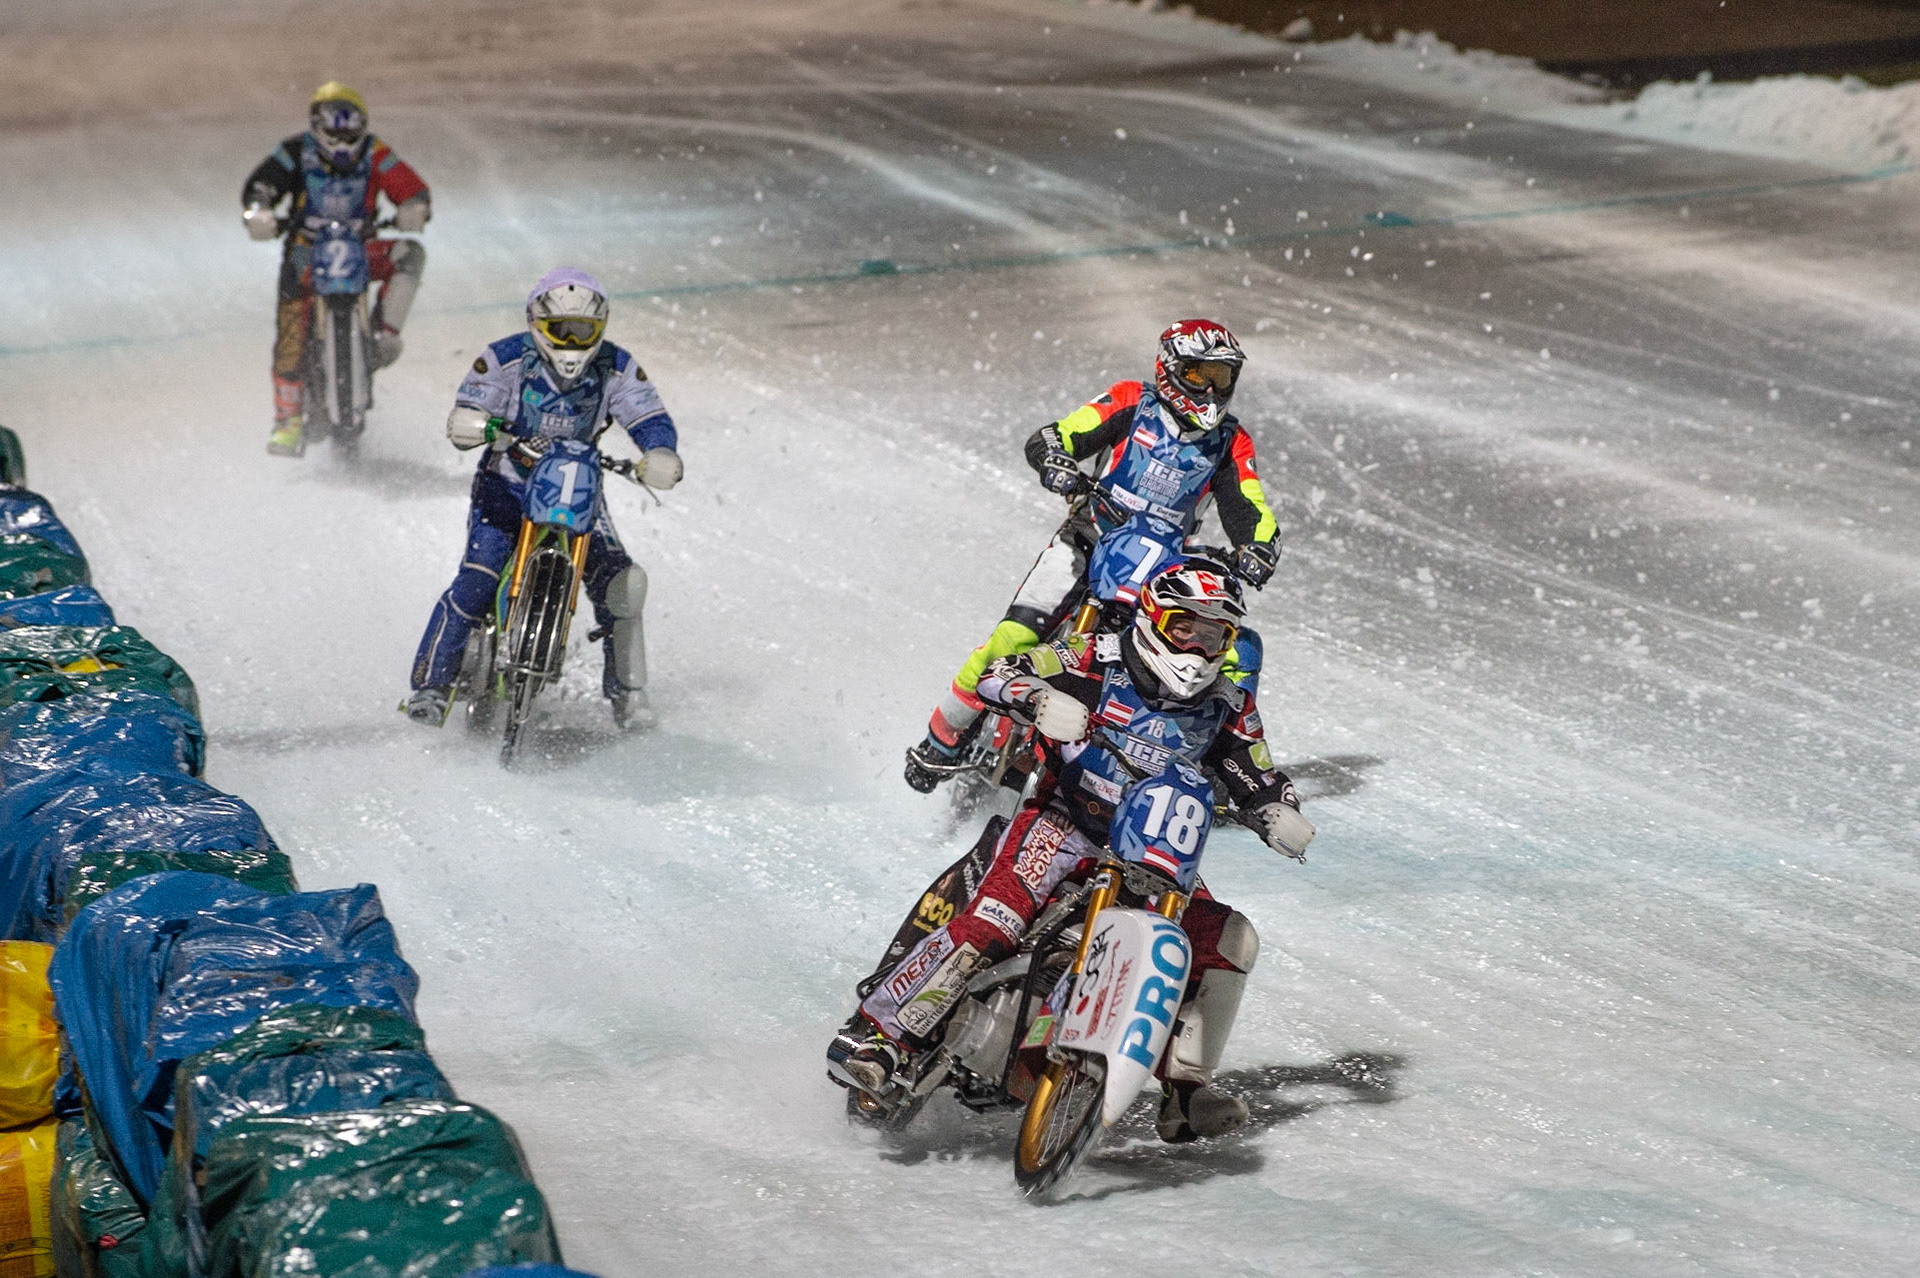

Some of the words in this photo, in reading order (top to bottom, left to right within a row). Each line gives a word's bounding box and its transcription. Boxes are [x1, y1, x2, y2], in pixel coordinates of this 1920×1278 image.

[326, 241, 350, 279] 2
[1170, 446, 1179, 461] 7
[557, 460, 579, 506] 1
[1146, 460, 1186, 482] ICE
[1129, 536, 1164, 585] 7
[1147, 719, 1166, 739] 18
[1124, 738, 1171, 769] ICE
[1144, 785, 1206, 855] 18
